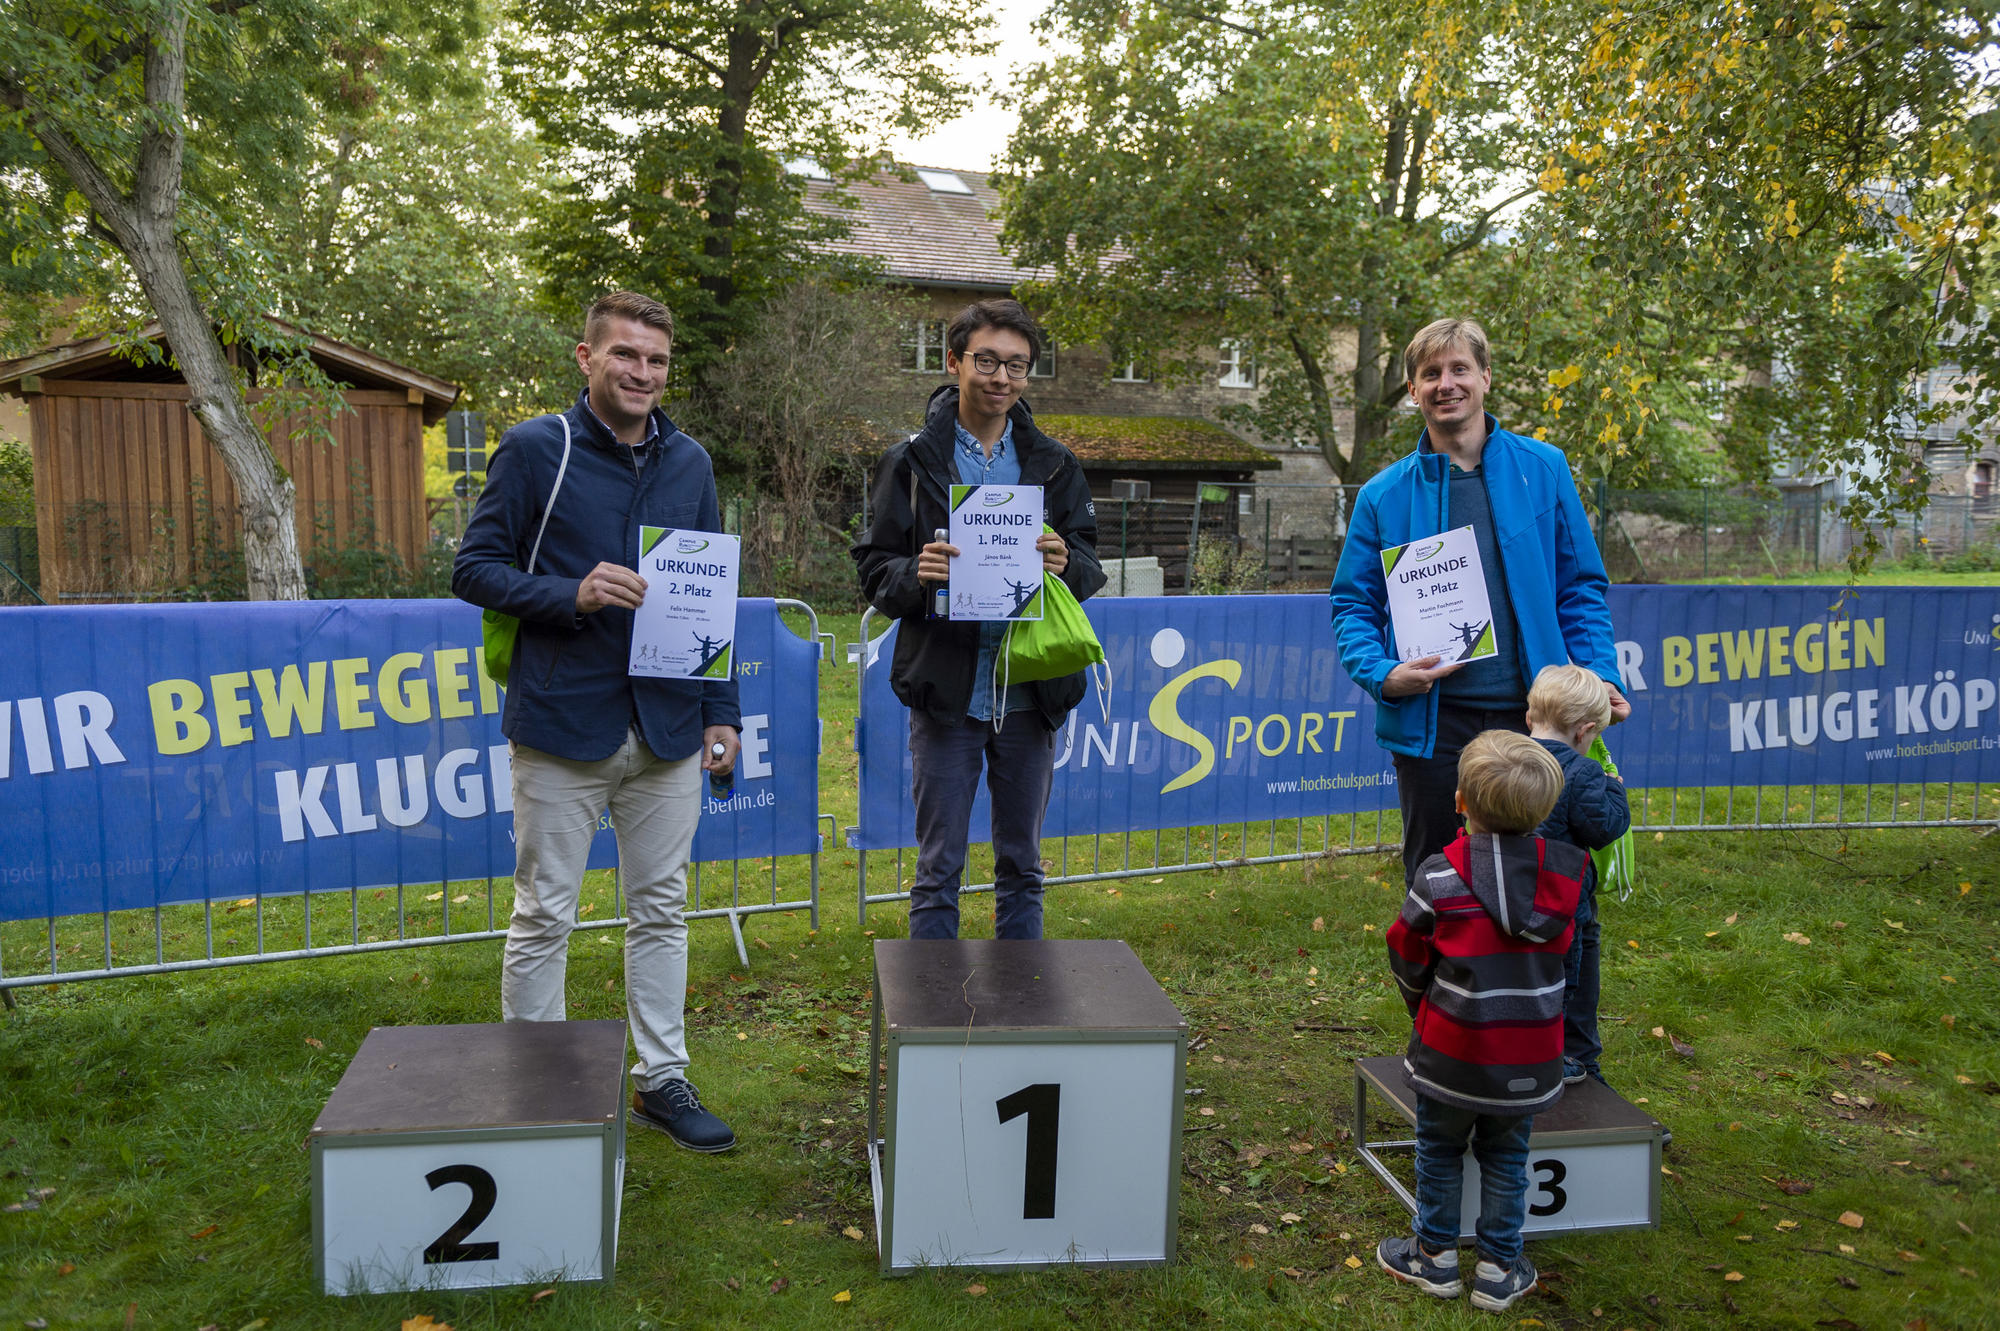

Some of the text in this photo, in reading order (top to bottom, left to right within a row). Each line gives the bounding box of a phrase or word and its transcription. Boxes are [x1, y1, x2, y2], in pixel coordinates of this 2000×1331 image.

[963, 513, 1032, 526] URKUNDE
[978, 534, 1019, 546] 1. Platz
[656, 558, 727, 578] URKUNDE
[1399, 556, 1469, 584] URKUNDE
[669, 582, 712, 598] 2. Platz
[1416, 581, 1459, 599] 3. Platz
[1419, 606, 1437, 614] Martin
[1662, 617, 1886, 687] BEWEGEN
[1729, 689, 1880, 752] KLUGE
[1894, 669, 2000, 735] KÖP
[1865, 735, 2000, 761] www.hochschulsport.fu-
[996, 1083, 1061, 1219] 1
[1528, 1158, 1567, 1217] 3
[424, 1164, 500, 1264] 2
